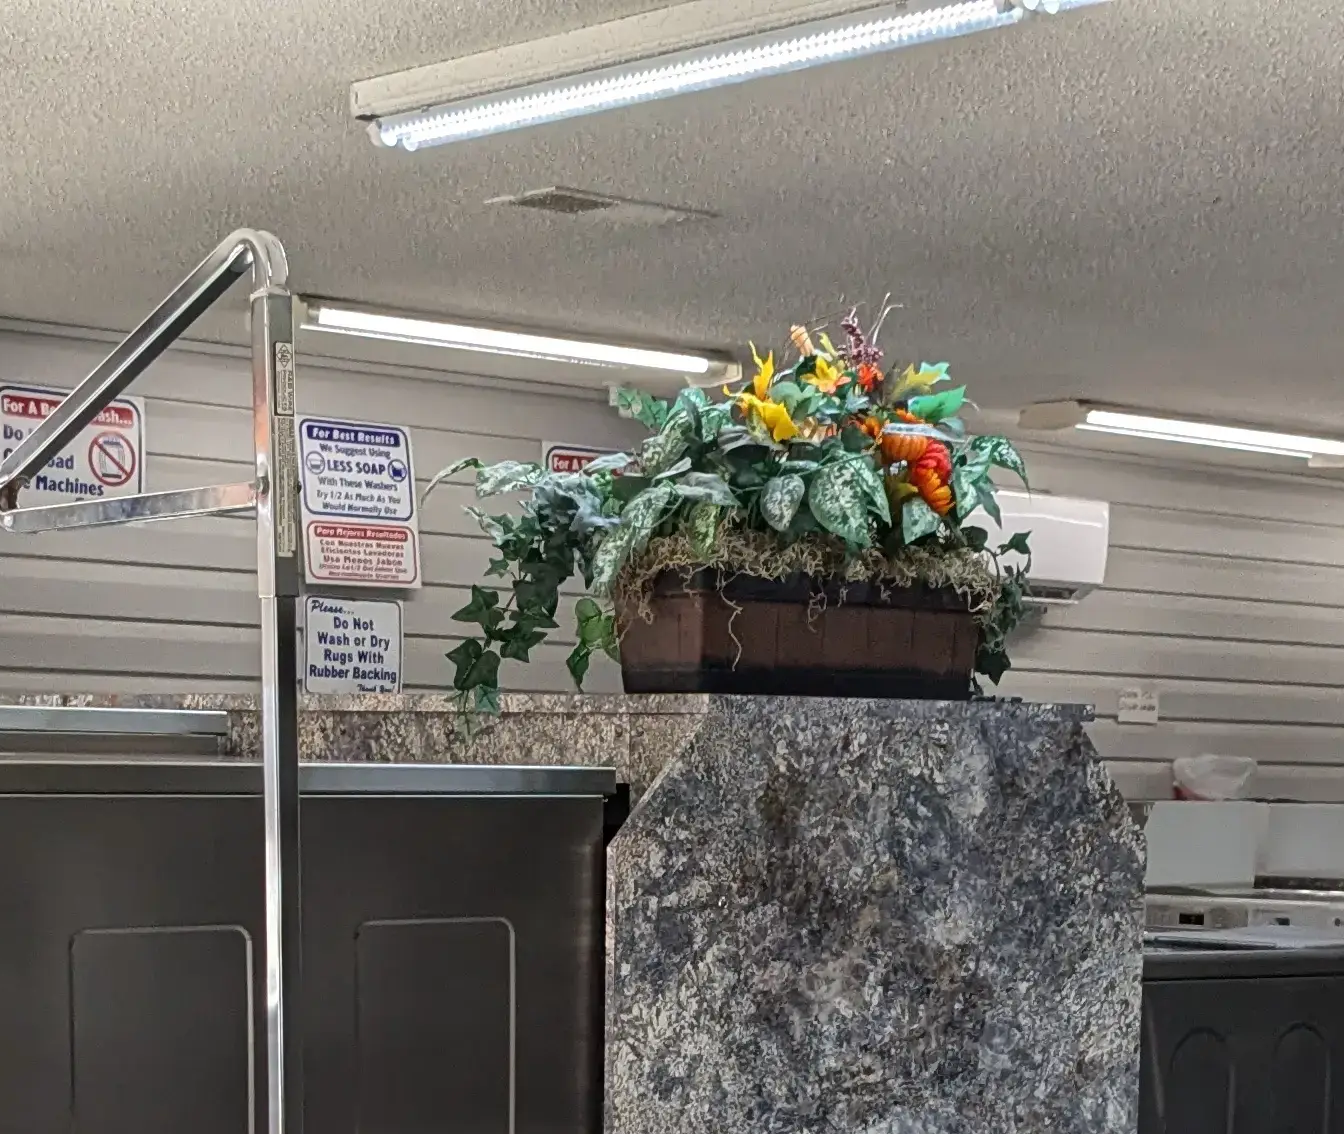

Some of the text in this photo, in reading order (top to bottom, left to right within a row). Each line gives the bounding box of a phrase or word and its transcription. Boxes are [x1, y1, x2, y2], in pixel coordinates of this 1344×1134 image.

[3, 397, 23, 411] For
[28, 401, 37, 415] A
[94, 410, 132, 425] ash...
[3, 424, 23, 441] Do
[312, 427, 395, 445] For Best Results
[319, 443, 391, 460] We Suggest Using
[327, 460, 386, 475] LESS SOAP
[553, 457, 569, 470] For
[572, 458, 579, 470] A
[36, 475, 104, 497] Machines
[318, 476, 398, 491] With These Washers
[316, 490, 328, 500] Try
[330, 491, 342, 500] 1/2
[322, 502, 398, 516] Would Normally Use
[311, 600, 354, 614] Please...
[333, 616, 374, 631] Do Not
[317, 631, 390, 651] Wash or Dry
[324, 648, 384, 665] Rugs With
[309, 664, 397, 684] Rubber Backing
